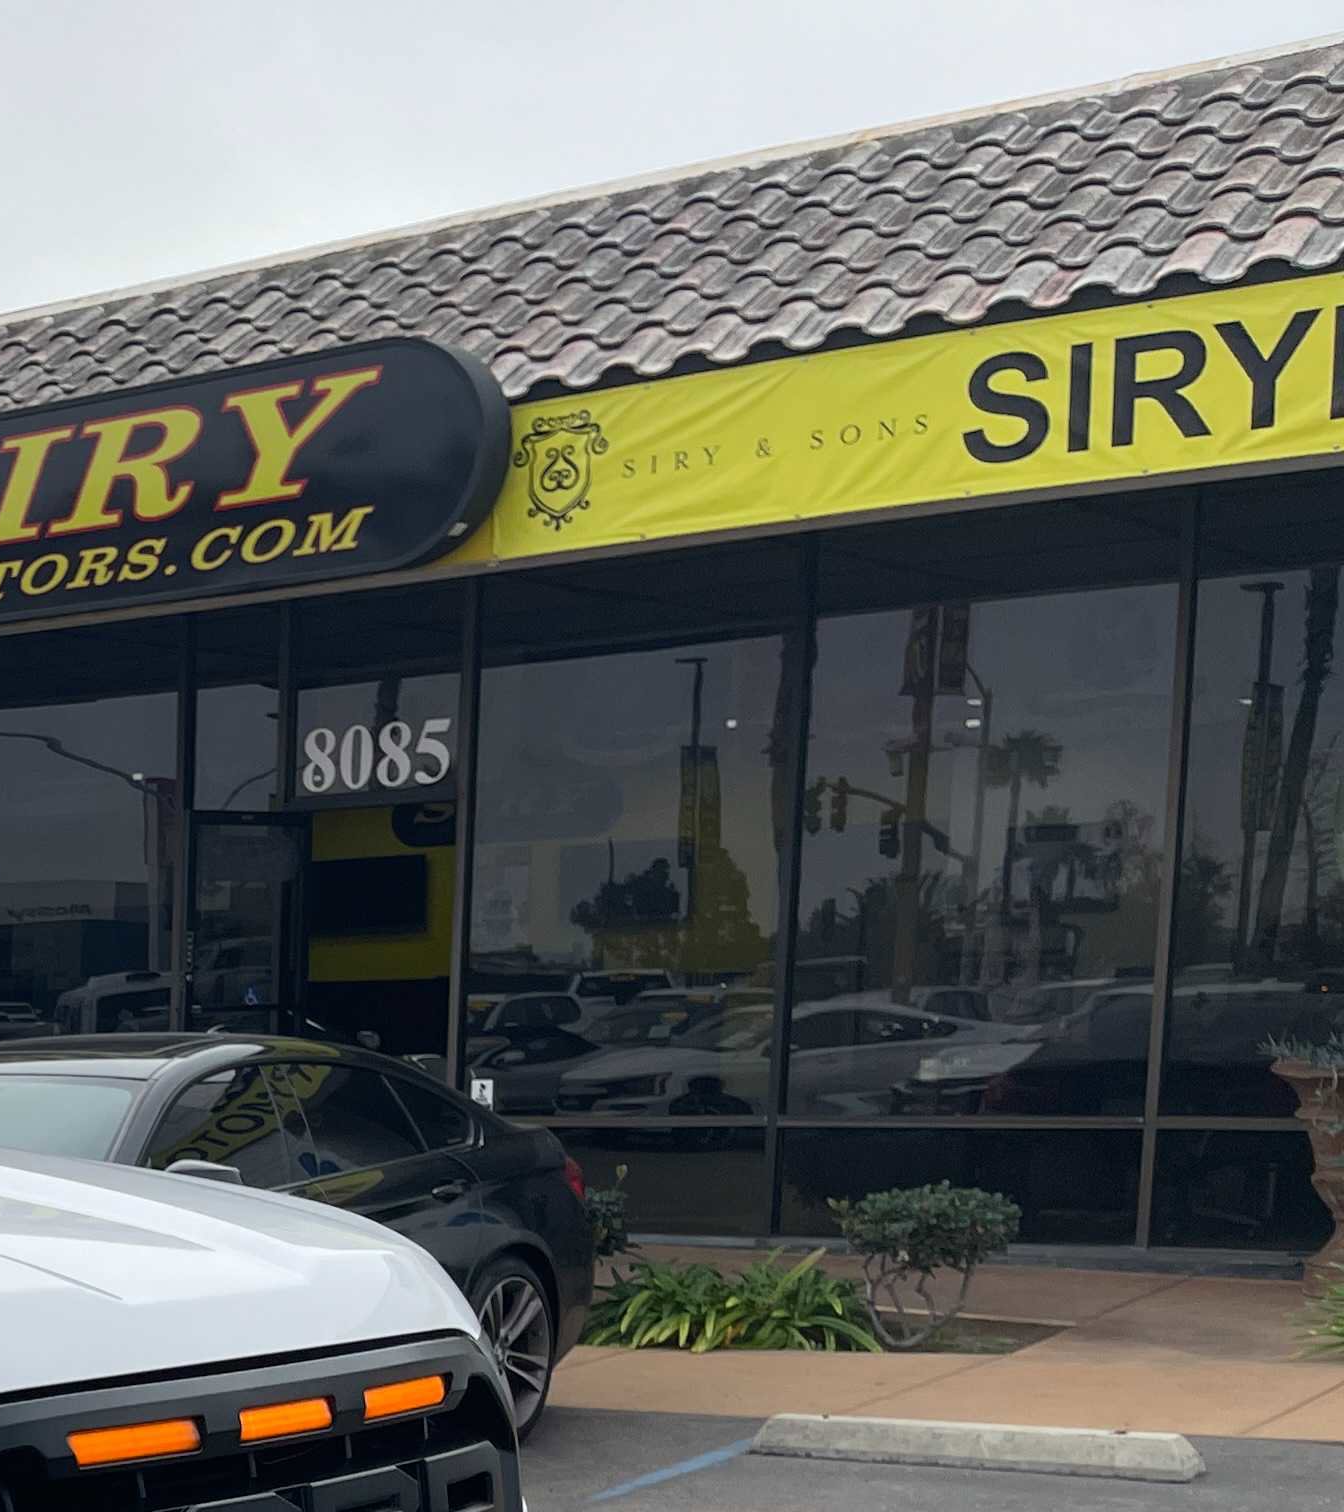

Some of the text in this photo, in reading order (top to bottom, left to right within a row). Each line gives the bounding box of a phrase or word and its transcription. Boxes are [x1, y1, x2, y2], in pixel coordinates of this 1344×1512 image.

[962, 304, 1344, 464] SIRY
[621, 413, 929, 479] SIRY & SONS
[301, 717, 452, 793] 8085
